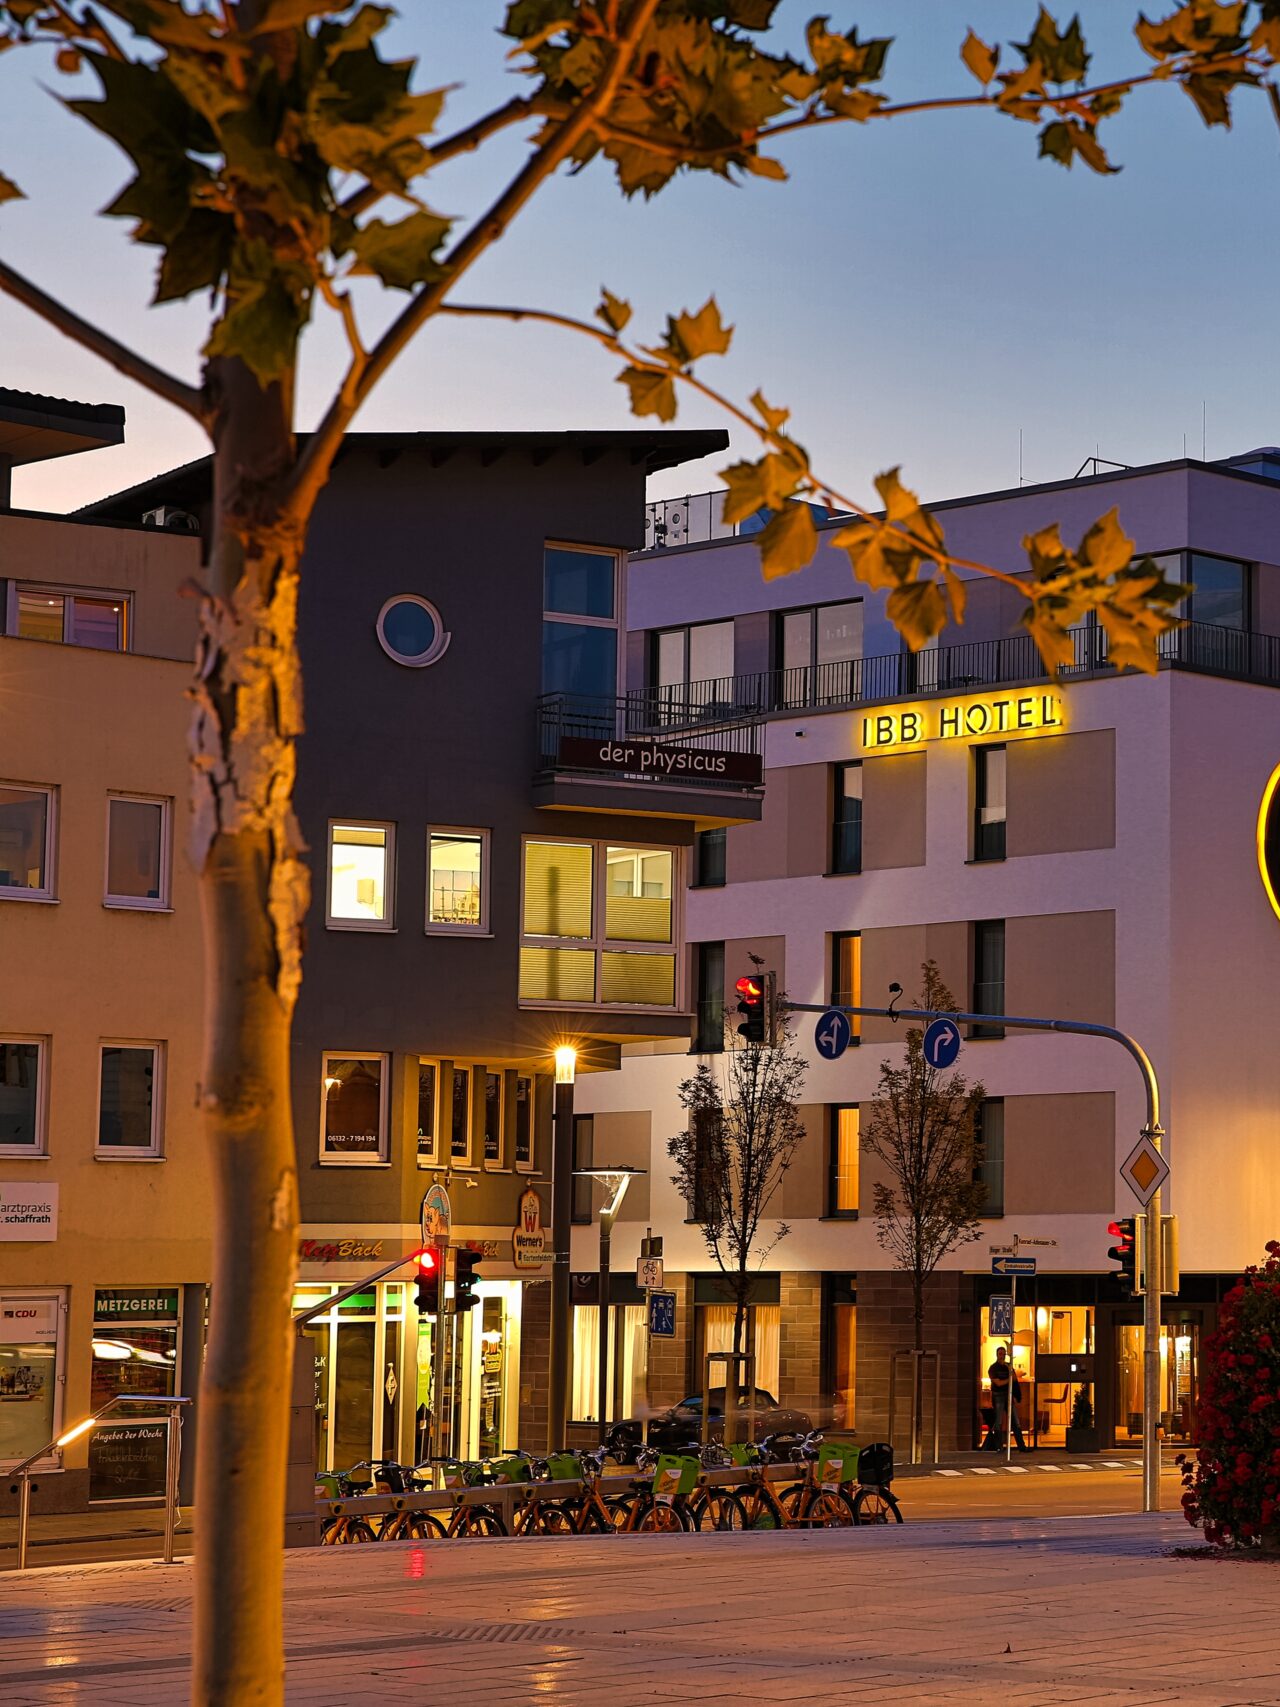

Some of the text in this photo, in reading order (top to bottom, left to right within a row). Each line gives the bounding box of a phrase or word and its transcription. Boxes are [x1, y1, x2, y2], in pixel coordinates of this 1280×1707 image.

[863, 695, 1062, 748] IBB HOTEL
[600, 741, 726, 773] der physicus
[5, 1215, 51, 1223] schaffrath
[516, 1234, 543, 1248] Werner's
[97, 1299, 168, 1311] METZGEREI
[15, 1310, 37, 1318] CDU
[91, 1428, 163, 1443] Angebot der Woche
